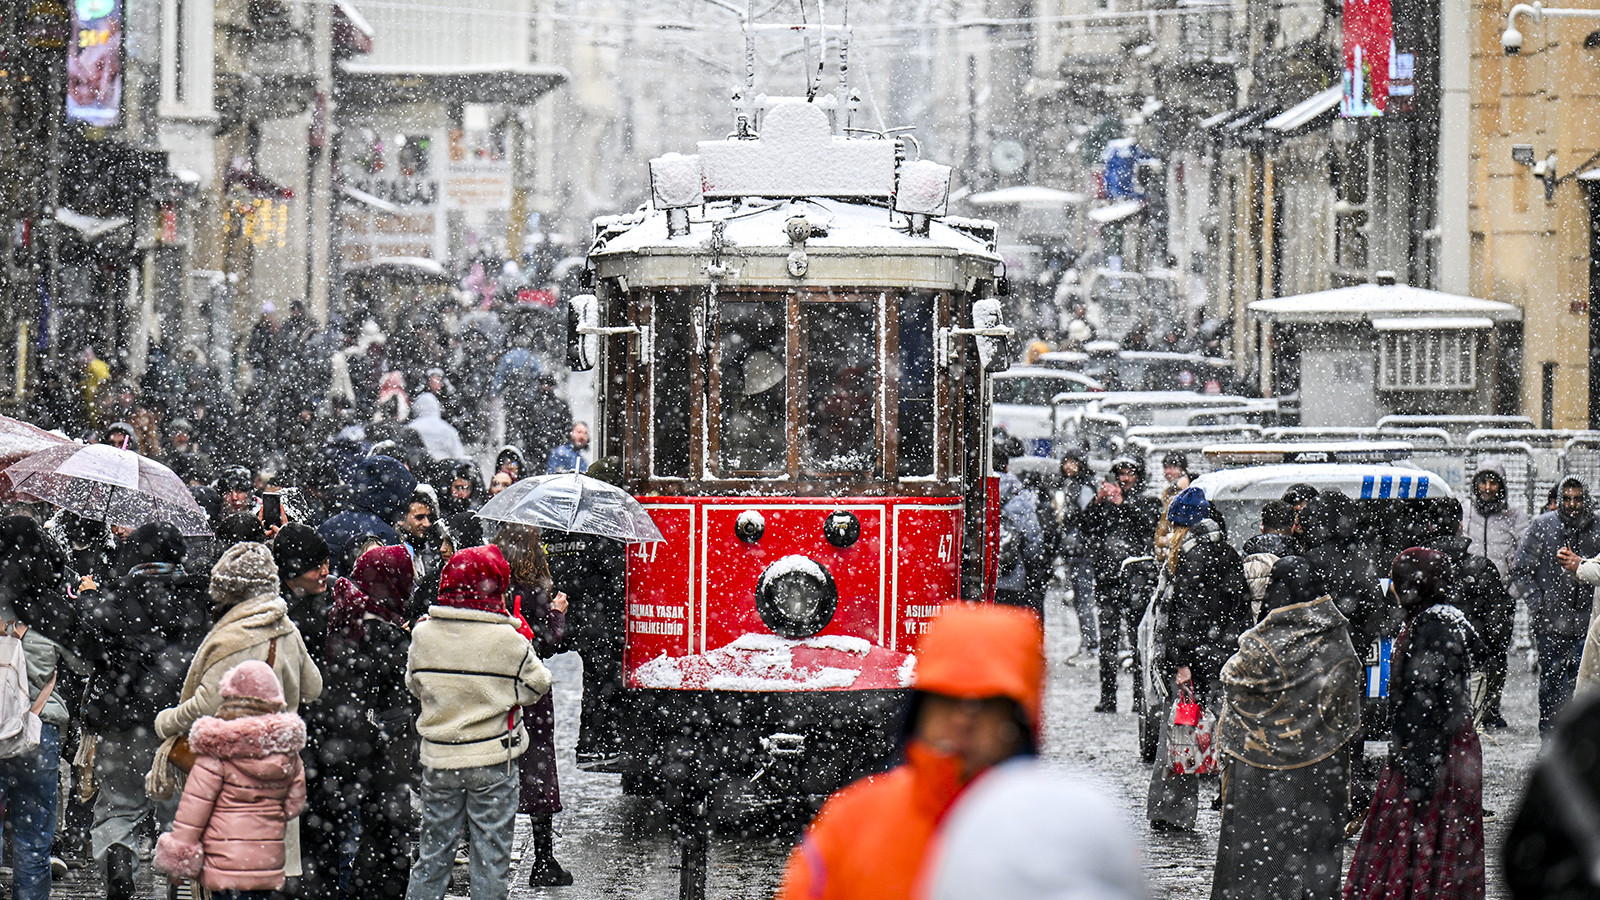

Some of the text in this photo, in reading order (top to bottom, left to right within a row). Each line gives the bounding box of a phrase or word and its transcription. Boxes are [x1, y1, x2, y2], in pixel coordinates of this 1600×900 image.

[938, 534, 953, 563] 47
[656, 605, 684, 619] YASAK
[905, 604, 941, 618] ASILMAK
[905, 621, 917, 635] VE
